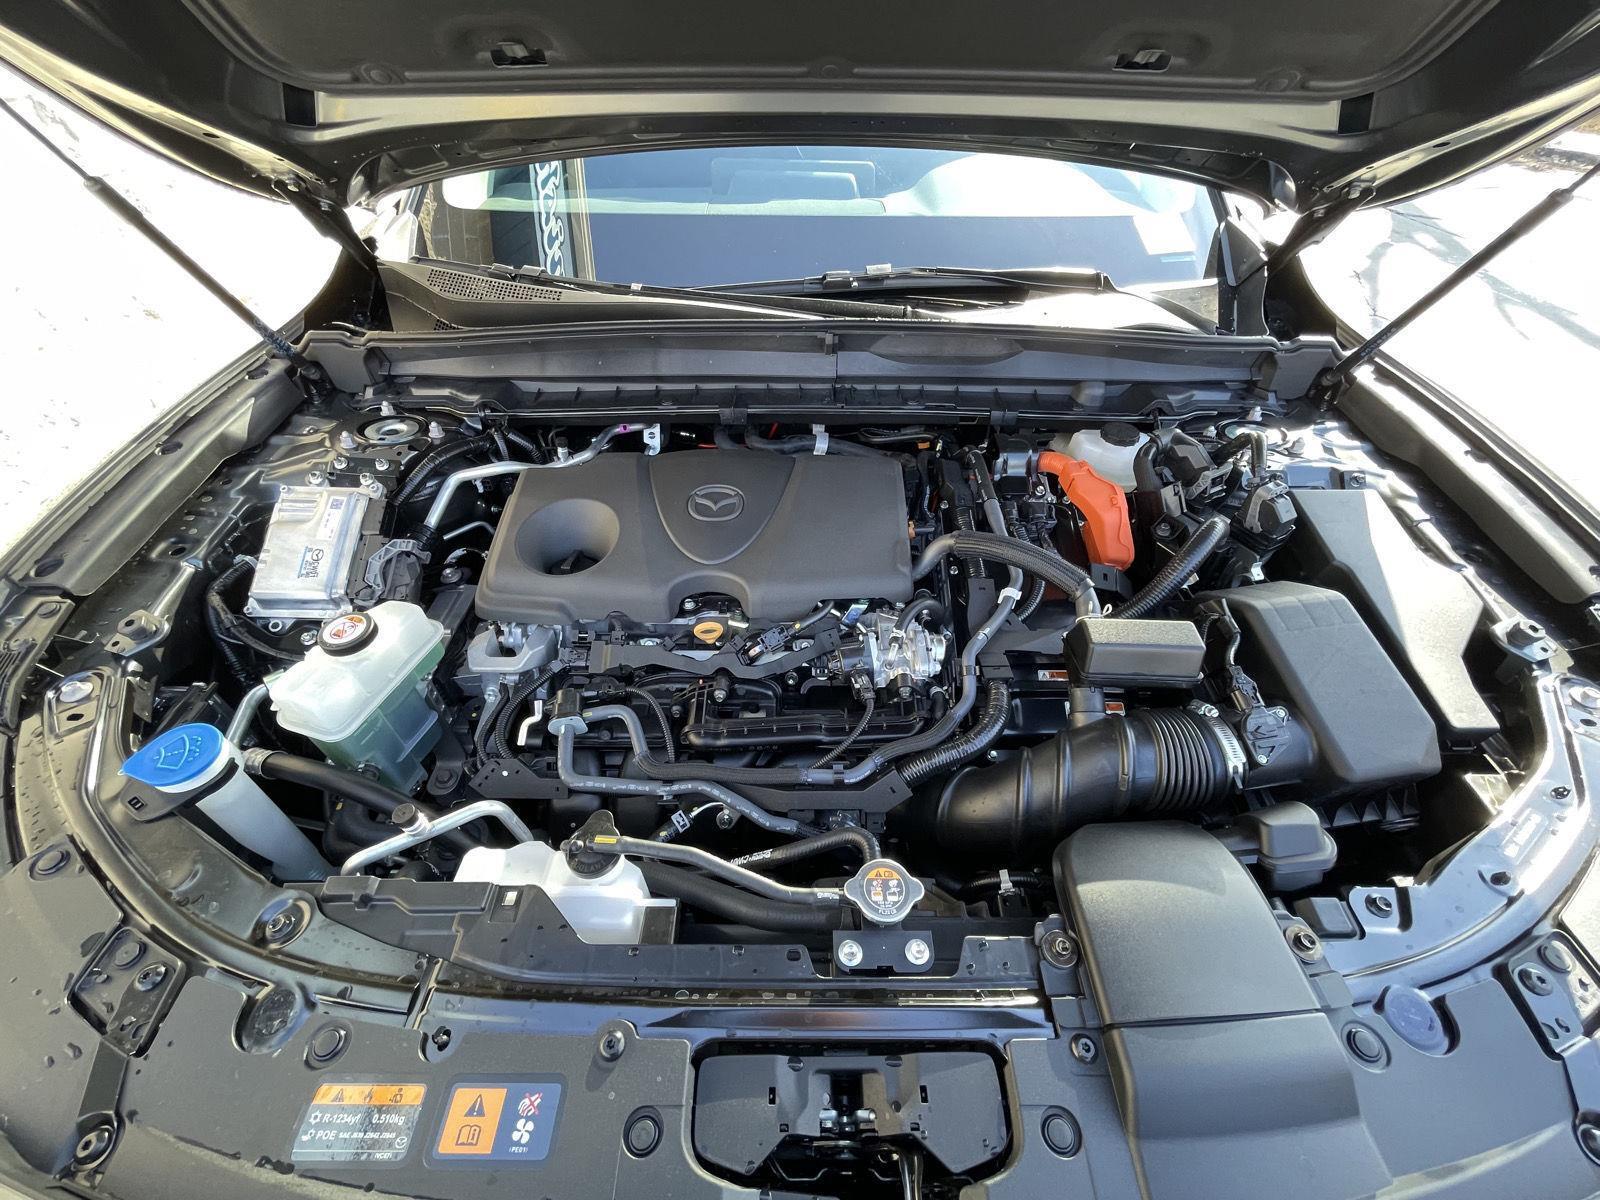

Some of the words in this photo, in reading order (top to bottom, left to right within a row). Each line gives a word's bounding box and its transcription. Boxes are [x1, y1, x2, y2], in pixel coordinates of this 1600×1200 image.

[322, 1113, 361, 1125] R-1234yf
[372, 1113, 405, 1125] 0.510kg
[315, 1130, 337, 1140] POE
